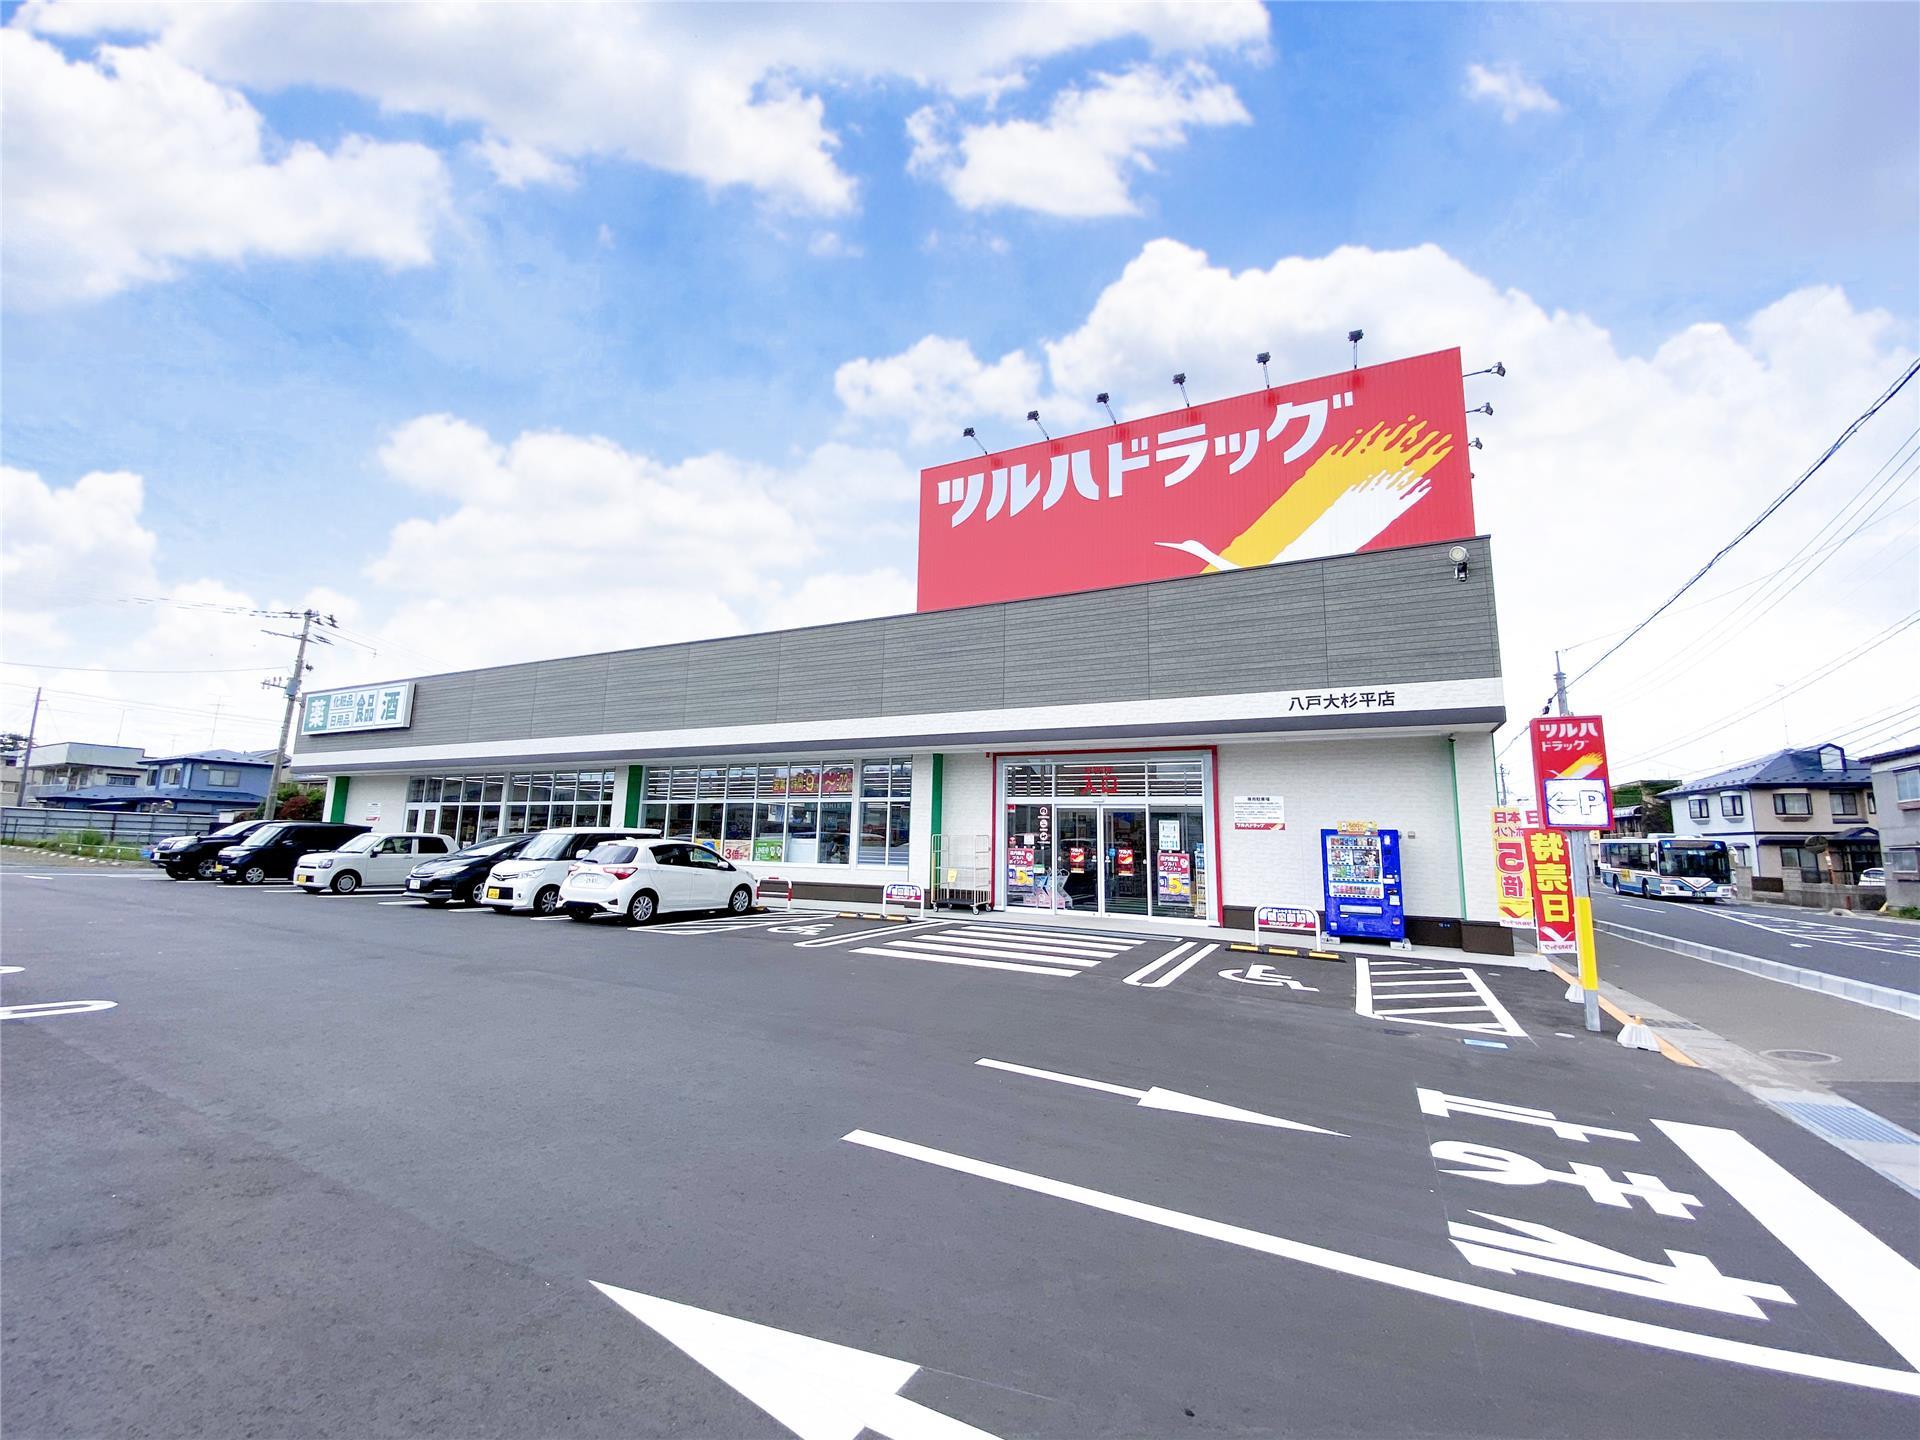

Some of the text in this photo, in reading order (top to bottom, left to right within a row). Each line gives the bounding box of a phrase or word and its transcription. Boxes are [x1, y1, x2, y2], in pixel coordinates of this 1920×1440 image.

[938, 391, 1355, 528] ツルハドラッグ
[332, 694, 354, 708] 化粧品
[381, 691, 401, 721] 酒
[1288, 690, 1396, 712] 八戸大杉平店
[308, 699, 326, 728] 薬
[330, 713, 350, 727] 日用品
[1539, 722, 1598, 738] ツルハ
[1541, 740, 1590, 752] ドラッグ
[1578, 790, 1606, 816] P
